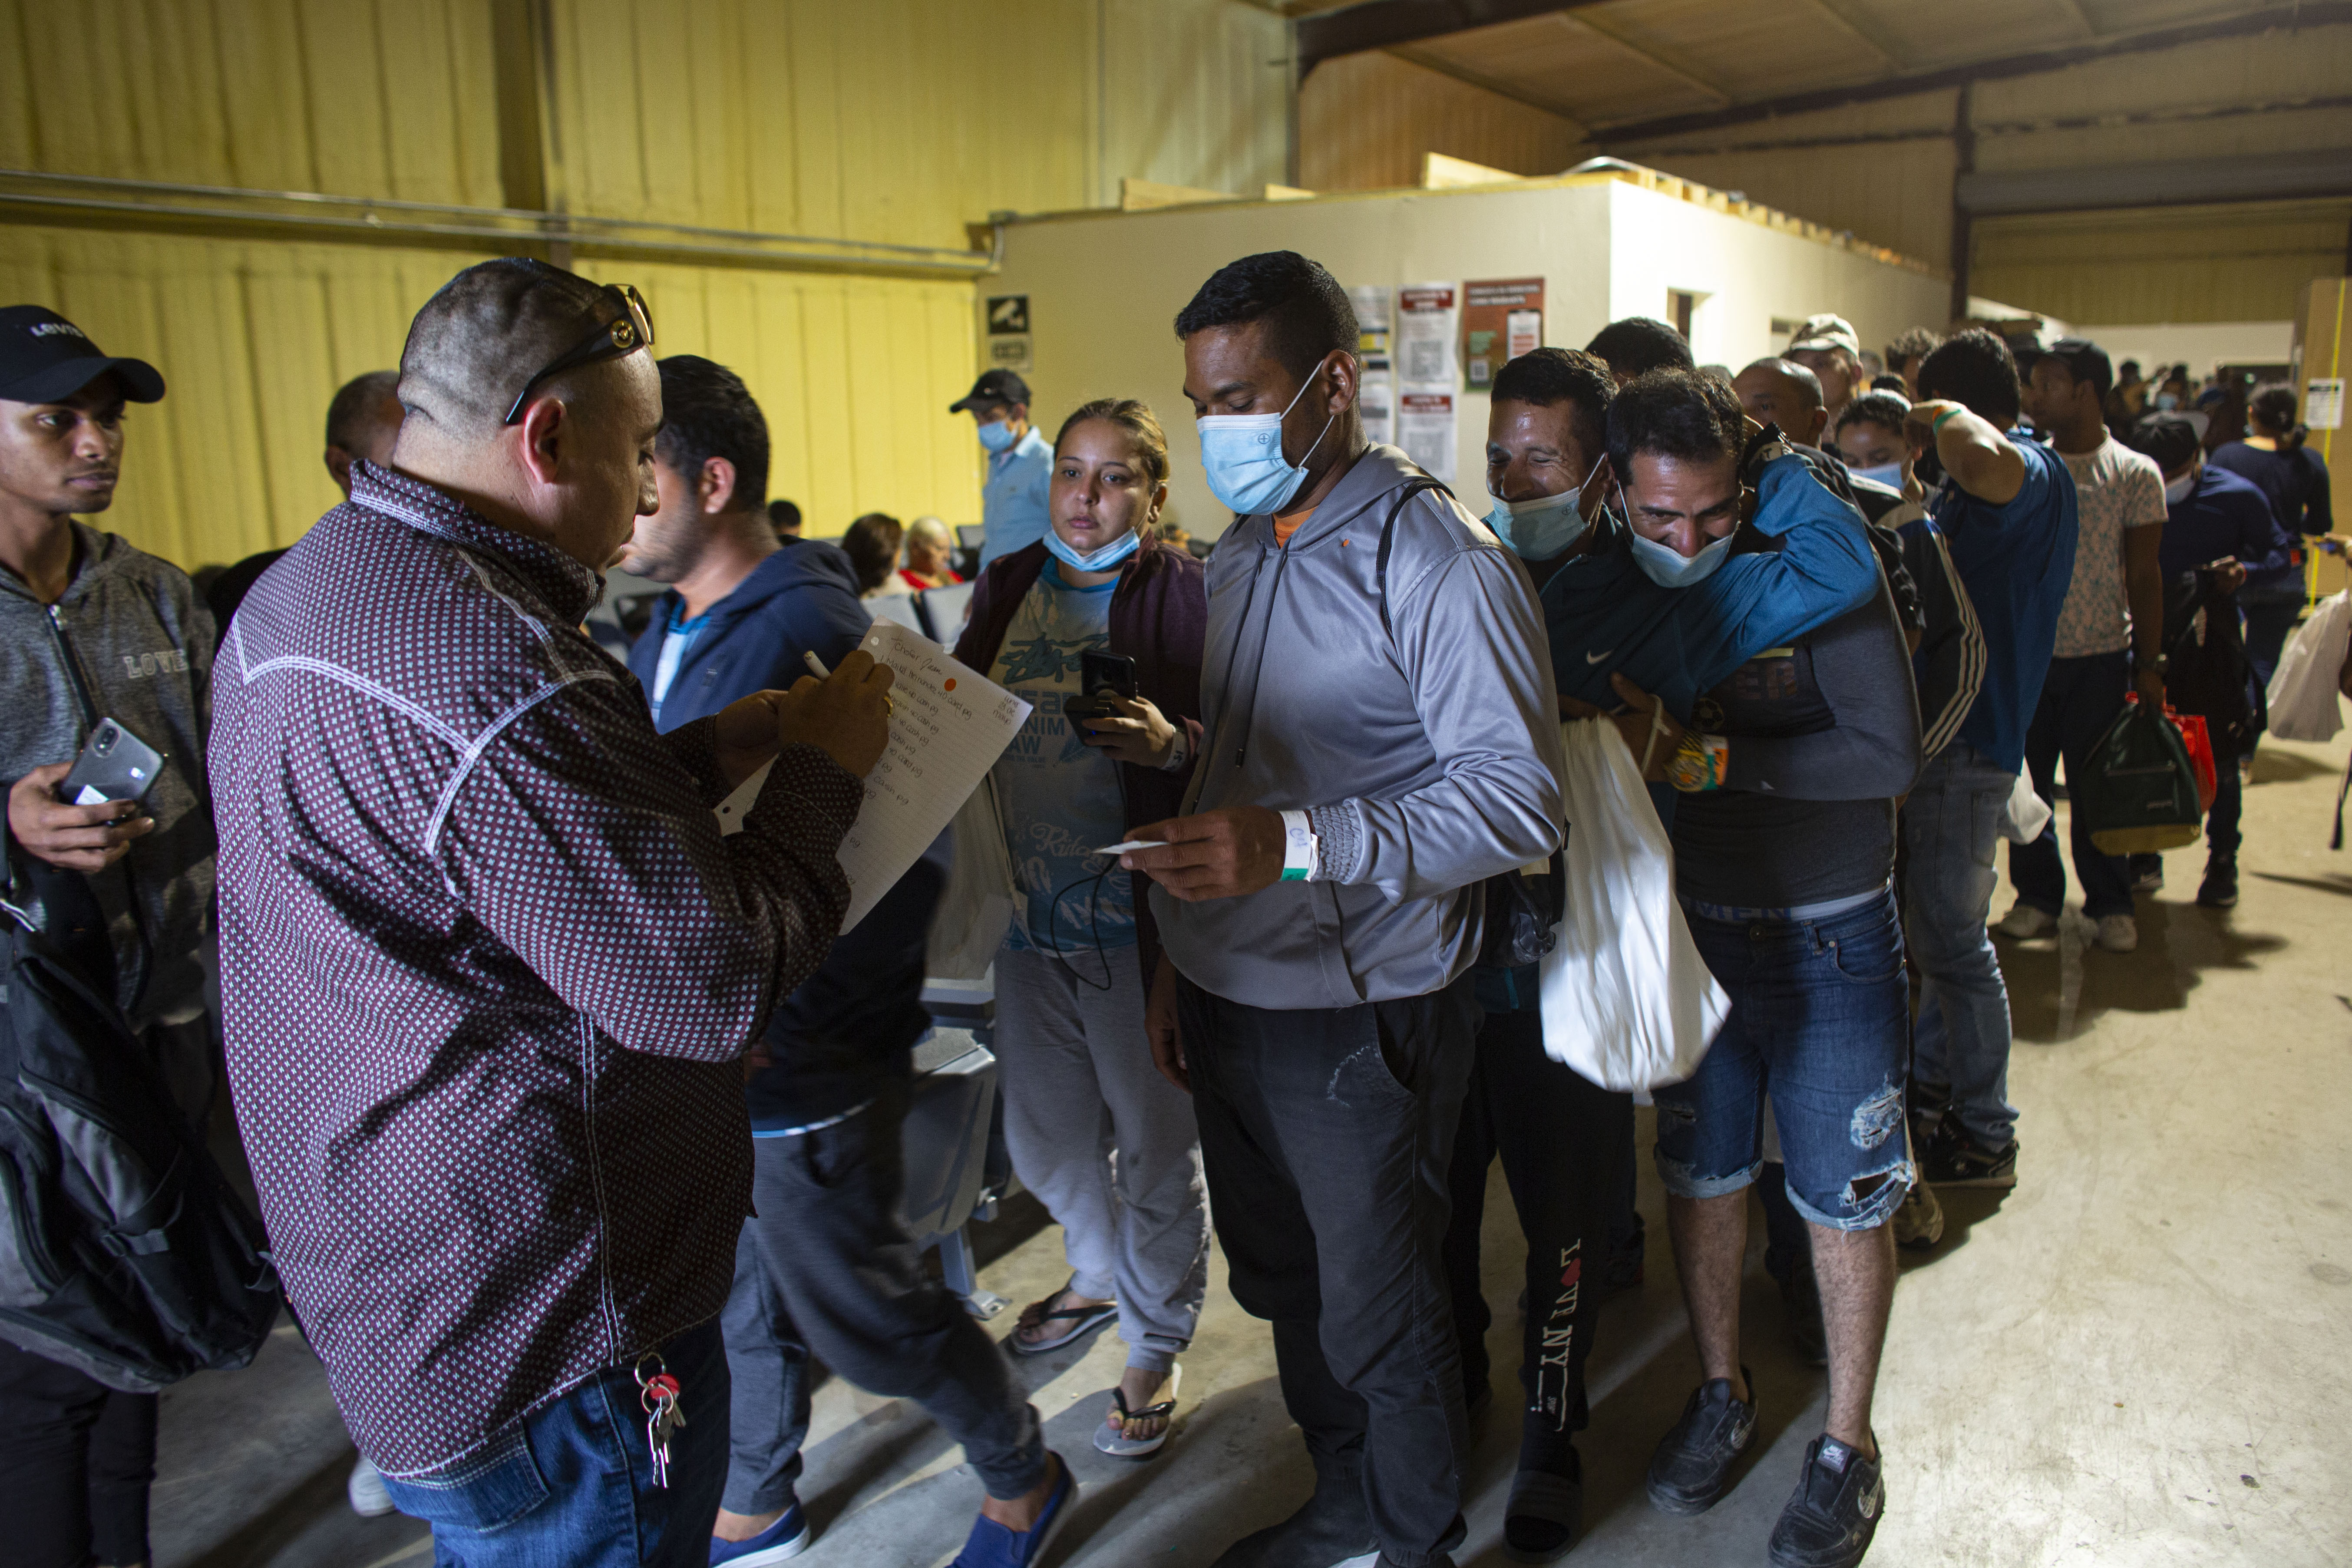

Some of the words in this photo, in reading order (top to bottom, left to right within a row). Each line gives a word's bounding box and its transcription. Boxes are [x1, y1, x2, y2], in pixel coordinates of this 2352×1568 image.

[123, 648, 189, 679] LOVE
[1018, 716, 1064, 736] NIM
[1008, 735, 1041, 754] AW
